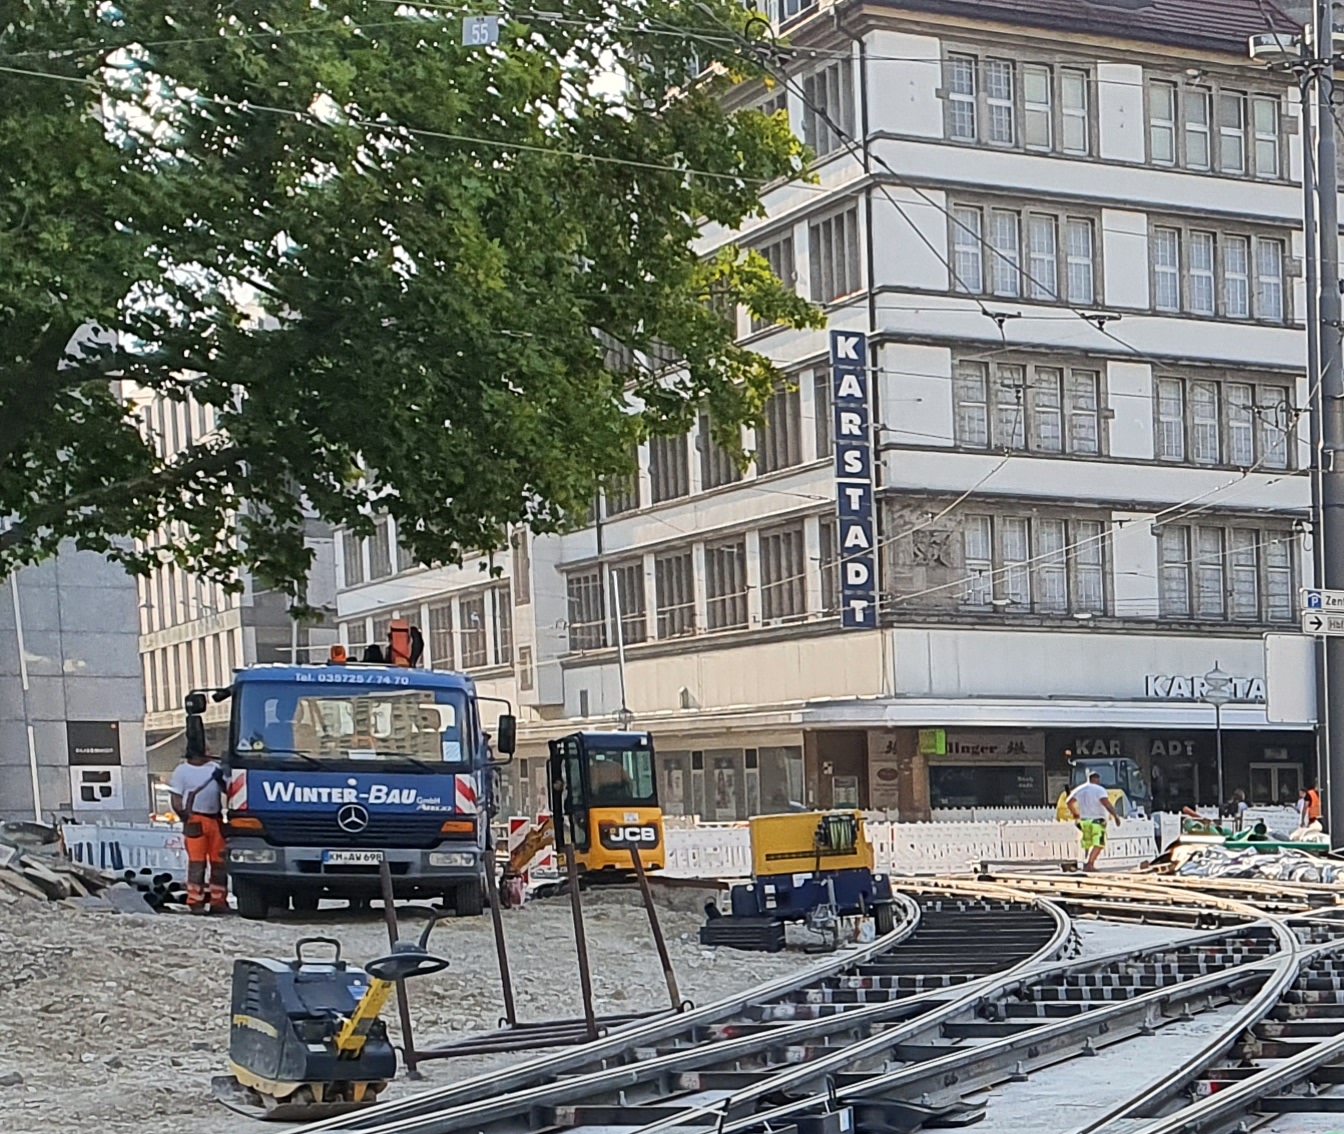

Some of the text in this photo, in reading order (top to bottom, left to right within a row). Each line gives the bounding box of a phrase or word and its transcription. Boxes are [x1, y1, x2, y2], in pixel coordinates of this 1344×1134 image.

[836, 335, 870, 623] KARSTADT
[1329, 619, 1344, 630] Hbf
[295, 672, 316, 682] Tel.
[317, 673, 365, 684] 035725
[1145, 675, 1267, 699] KARTA
[262, 780, 417, 805] WINTER-BAU
[609, 827, 656, 842] JCB
[363, 853, 382, 862] 698
